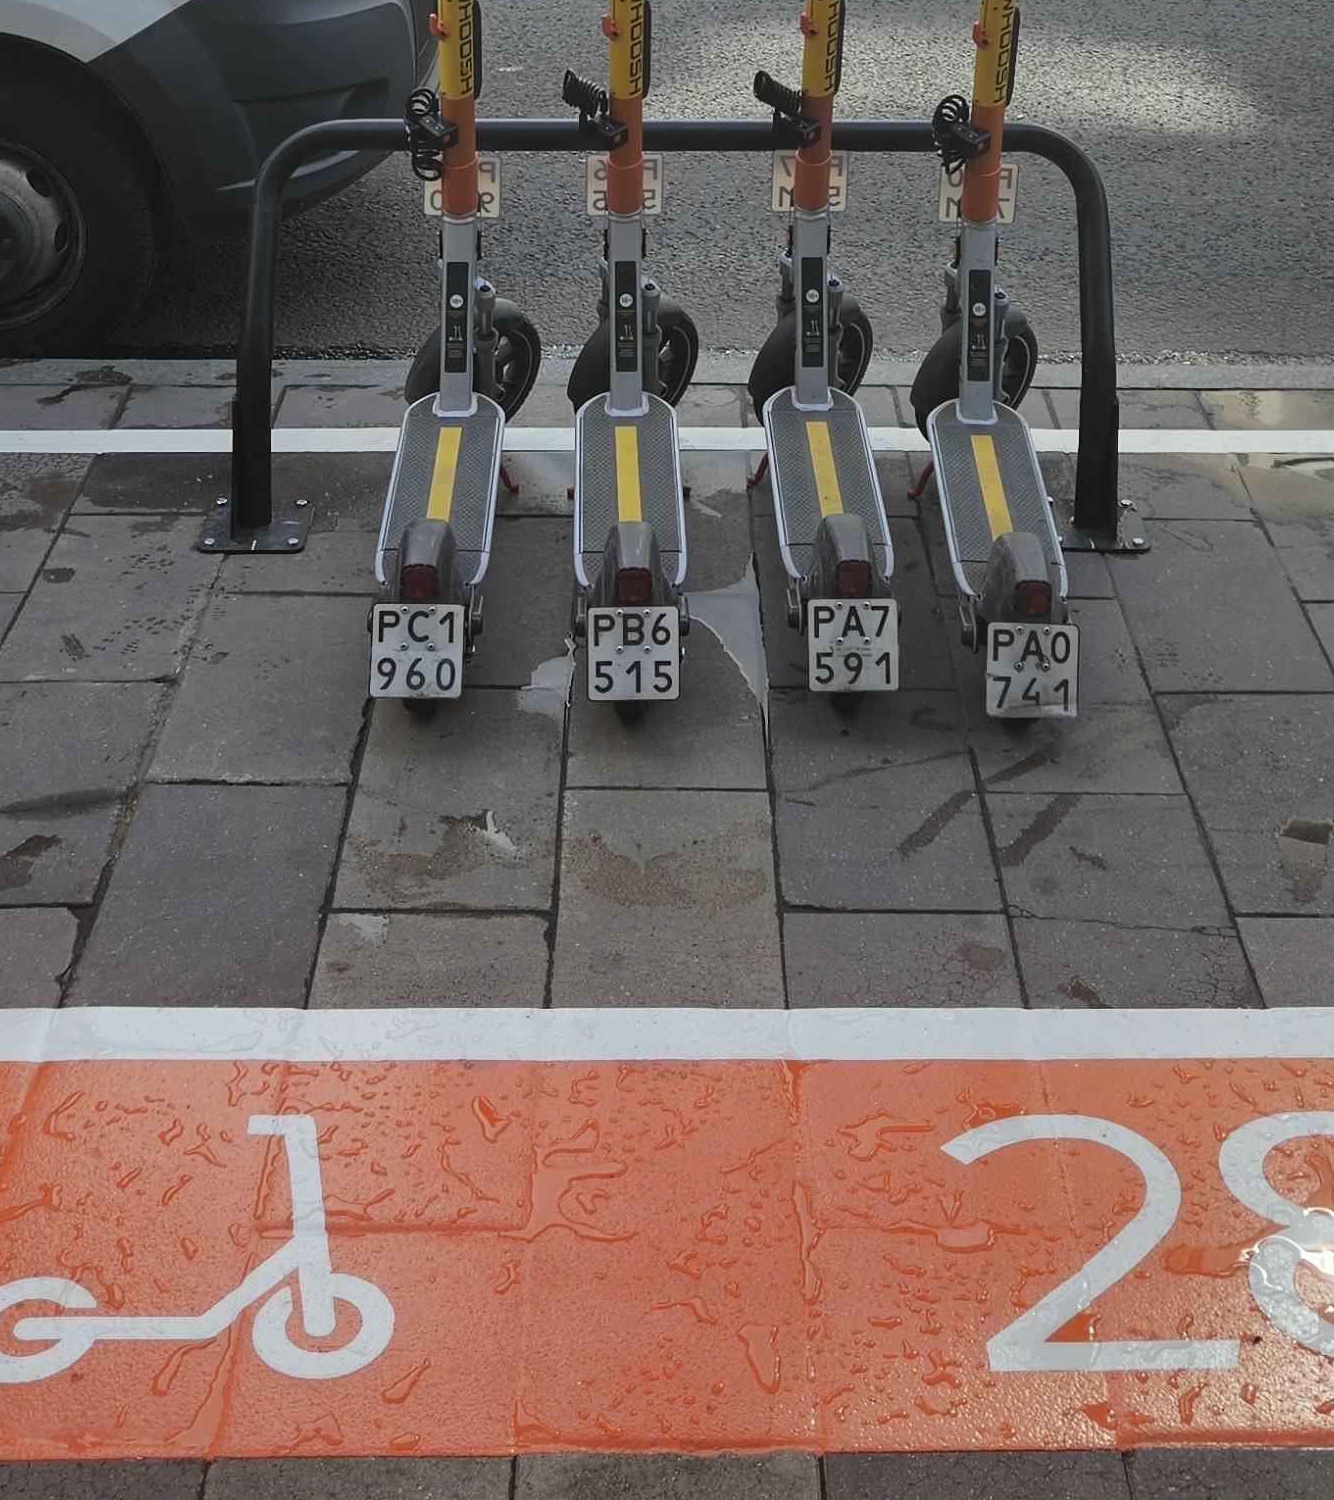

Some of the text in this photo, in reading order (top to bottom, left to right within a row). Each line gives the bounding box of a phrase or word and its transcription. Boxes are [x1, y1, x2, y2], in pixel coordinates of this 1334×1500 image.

[377, 610, 456, 644] РС1
[593, 612, 672, 647] РВ6
[813, 605, 891, 639] РА7
[992, 628, 1072, 665] РА0
[376, 657, 457, 692] 960
[593, 659, 674, 694] 515
[814, 651, 892, 685] 591
[991, 675, 1071, 712] 741
